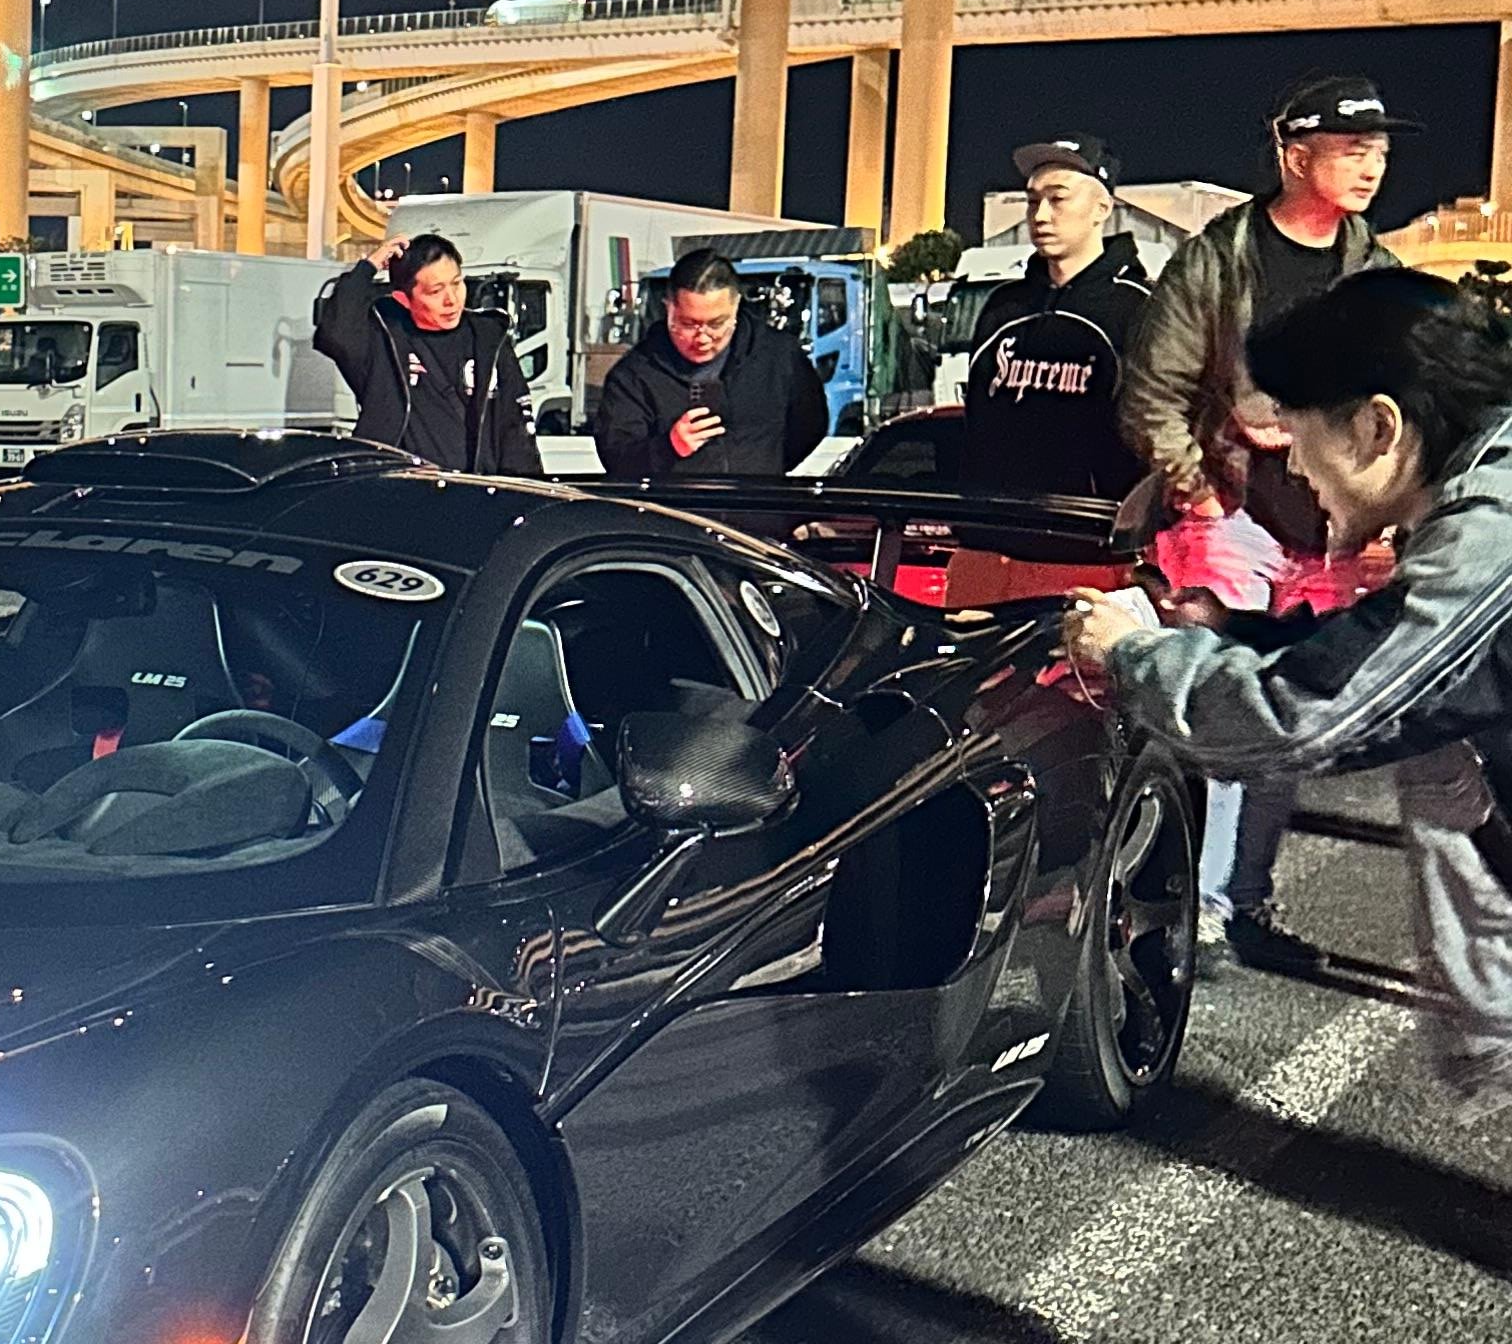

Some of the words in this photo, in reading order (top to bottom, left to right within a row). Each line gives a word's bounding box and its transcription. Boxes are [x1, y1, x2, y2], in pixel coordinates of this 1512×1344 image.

[989, 336, 1092, 404] Supreme
[1, 409, 29, 417] ISUZU
[354, 567, 425, 593] 629
[131, 671, 164, 686] LM
[163, 674, 187, 688] 25
